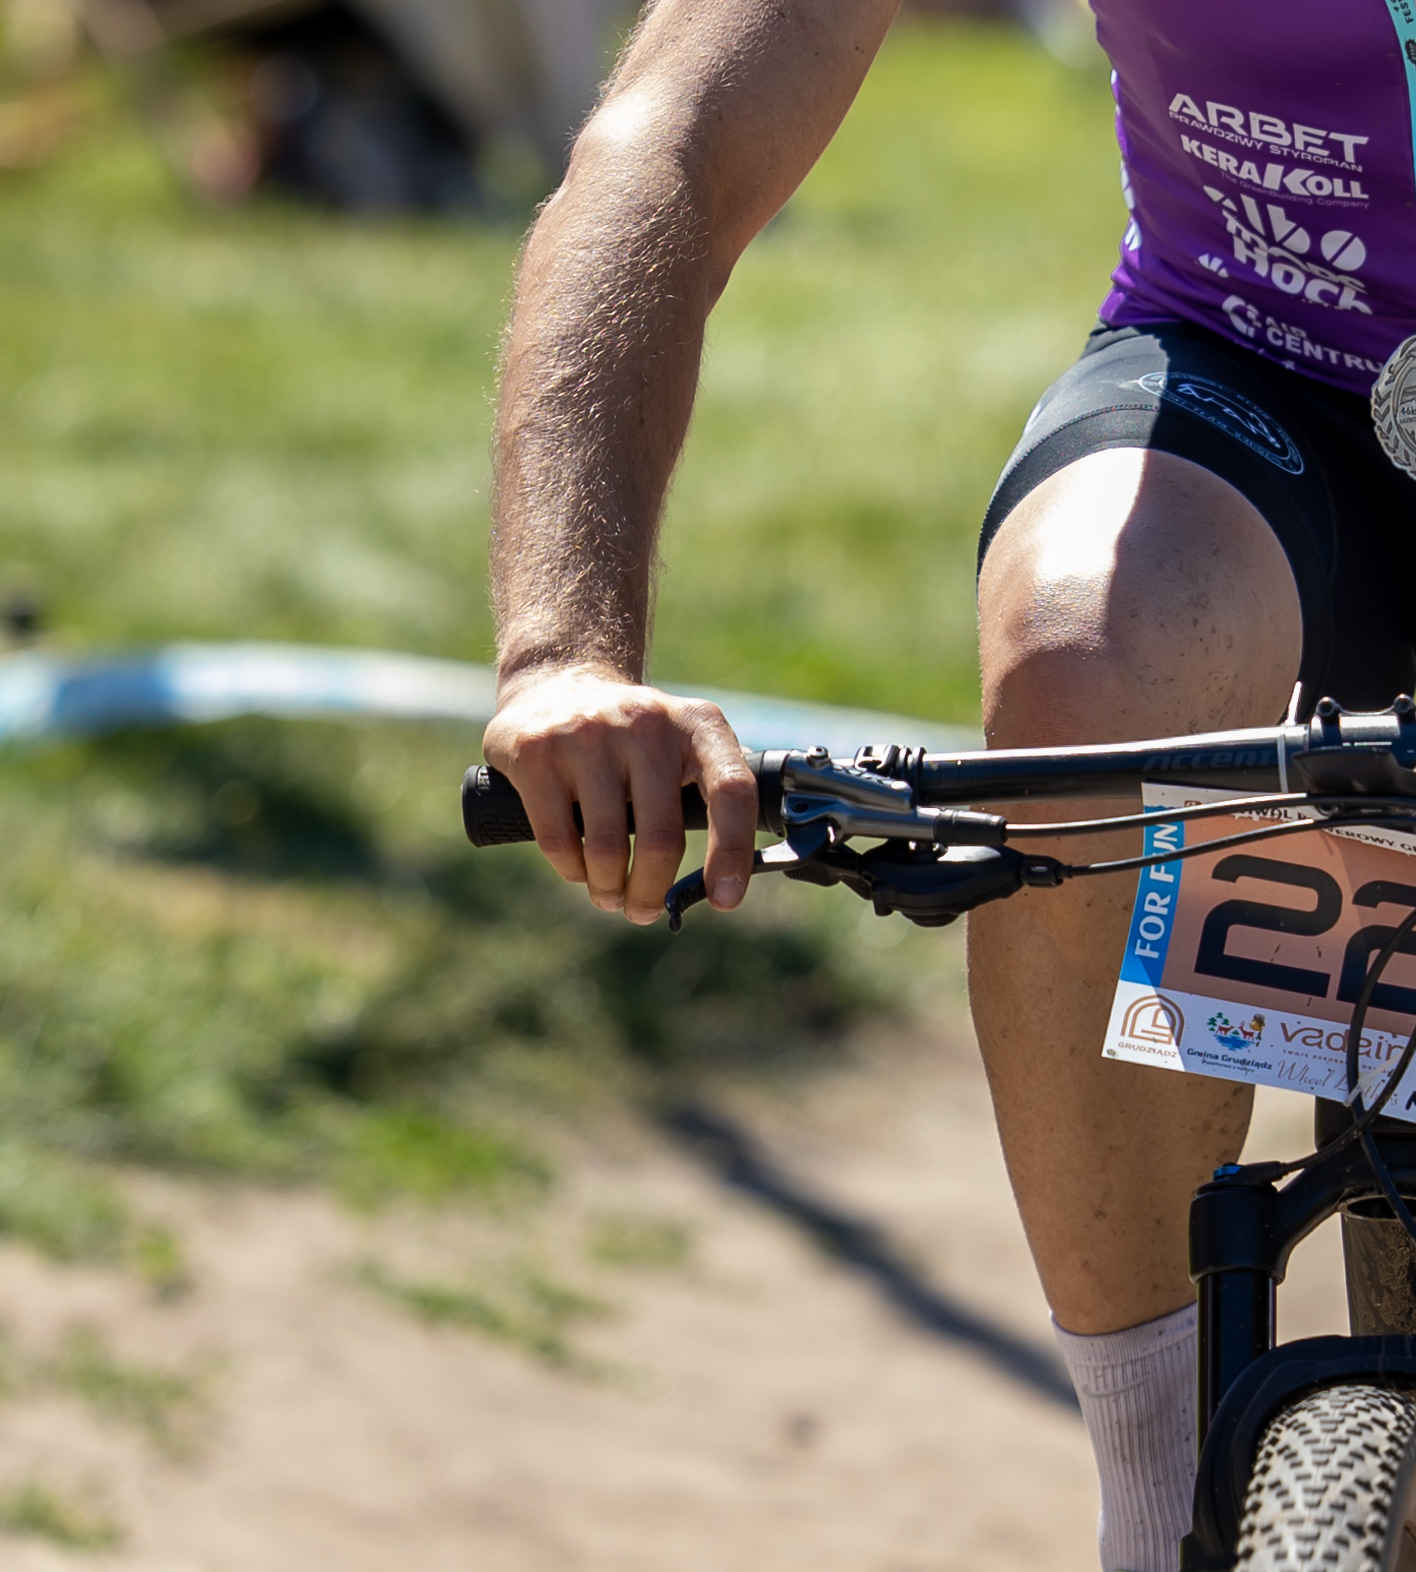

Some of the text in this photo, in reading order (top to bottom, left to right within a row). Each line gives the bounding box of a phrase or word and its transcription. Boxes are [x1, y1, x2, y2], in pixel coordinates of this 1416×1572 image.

[1168, 92, 1369, 163] ARBET
[1168, 110, 1363, 173] PRAWDZIWY STYROPIAN
[1180, 133, 1369, 200] KERAKOLL
[1316, 197, 1370, 209] Company
[1134, 892, 1171, 959] FOR
[1117, 1041, 1178, 1059] GRUDZIĄDZ
[1221, 1054, 1273, 1070] Grudziądz
